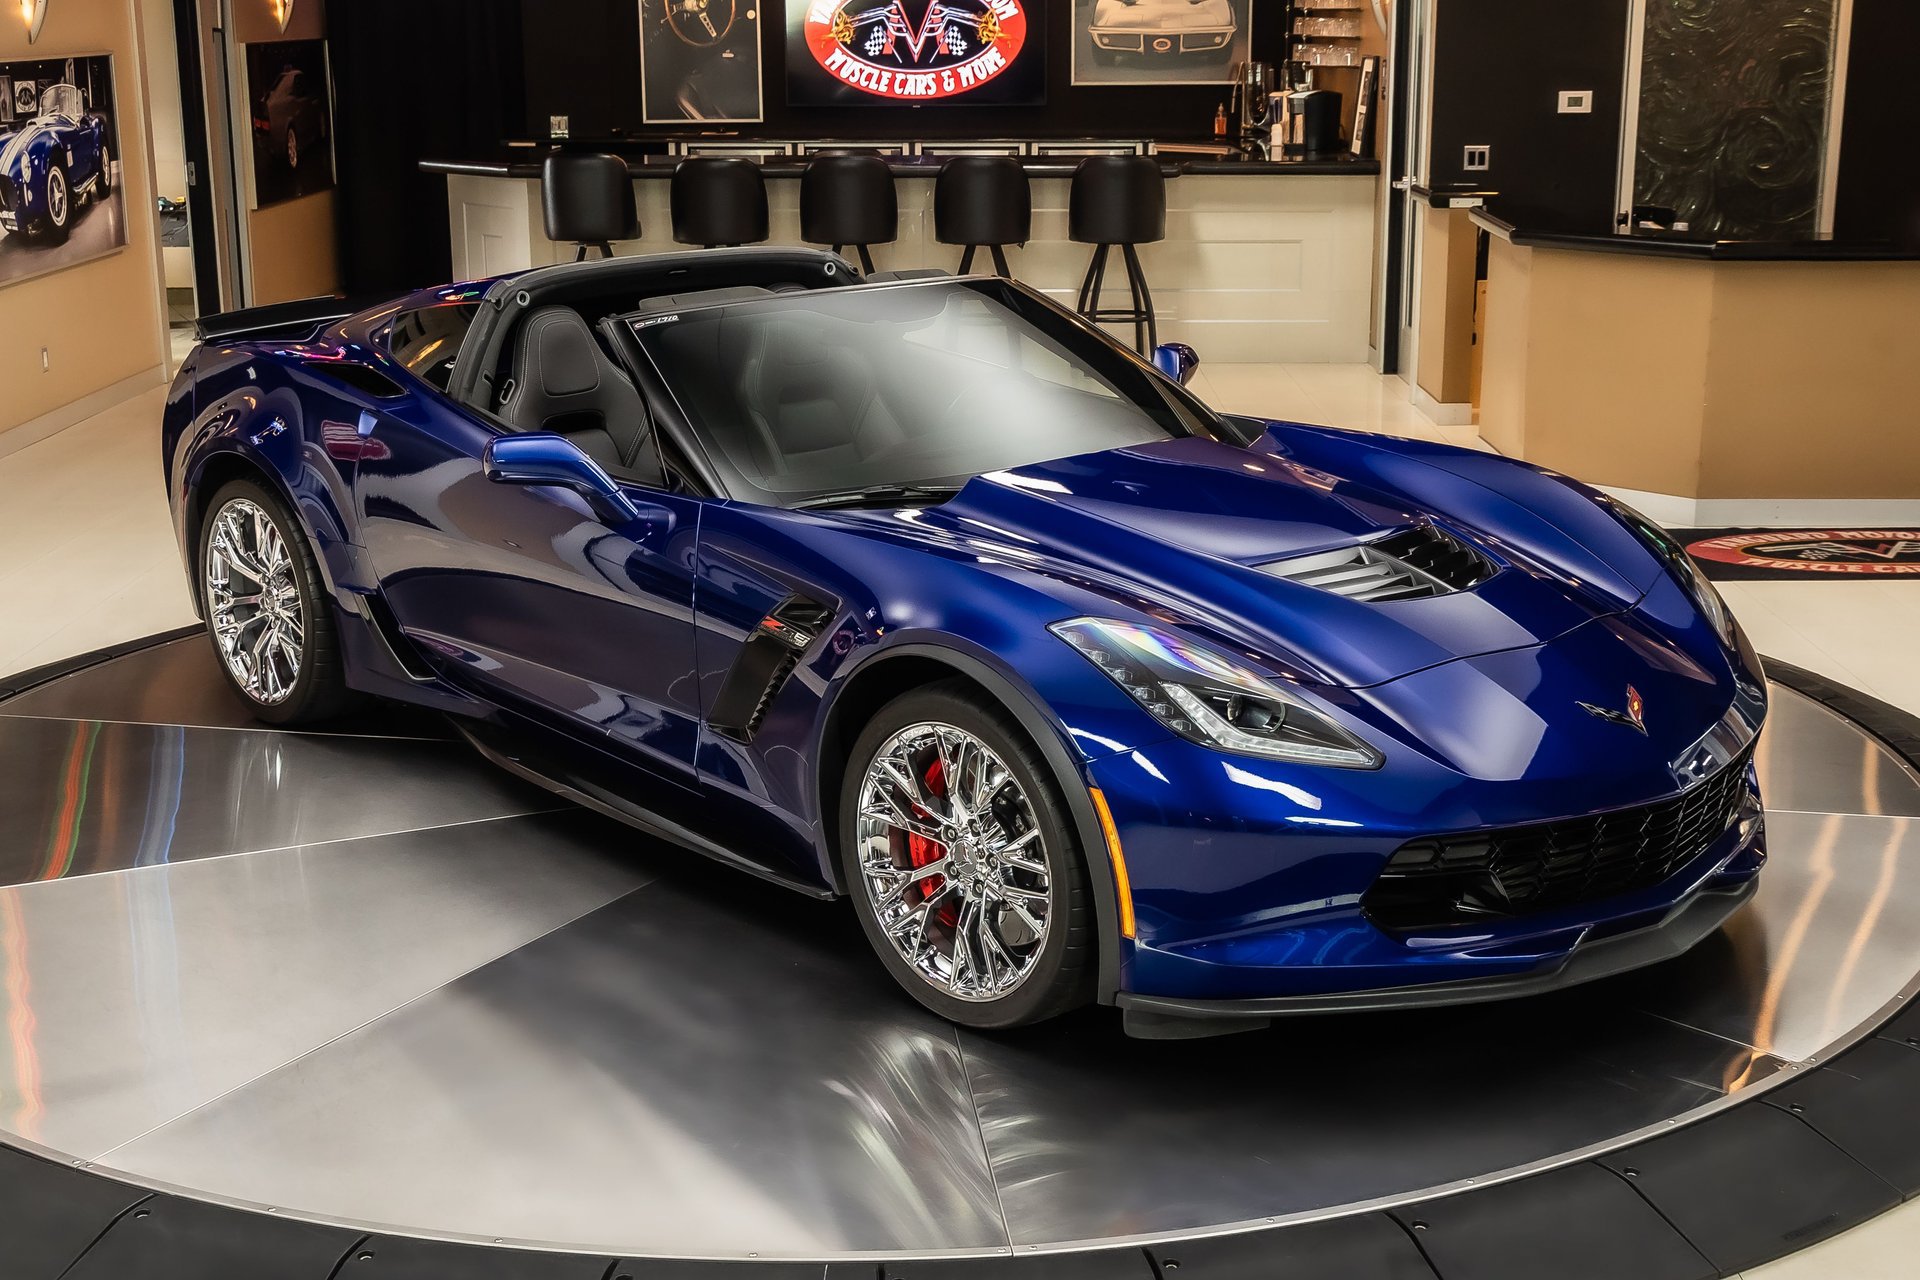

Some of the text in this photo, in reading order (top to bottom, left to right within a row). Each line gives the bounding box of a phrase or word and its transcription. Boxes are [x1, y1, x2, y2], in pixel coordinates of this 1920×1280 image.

[824, 46, 1007, 96] MUSCLE CARS & MORE
[1698, 531, 1920, 550] VANGUARD MOTO
[1738, 557, 1864, 573] MUSCLE
